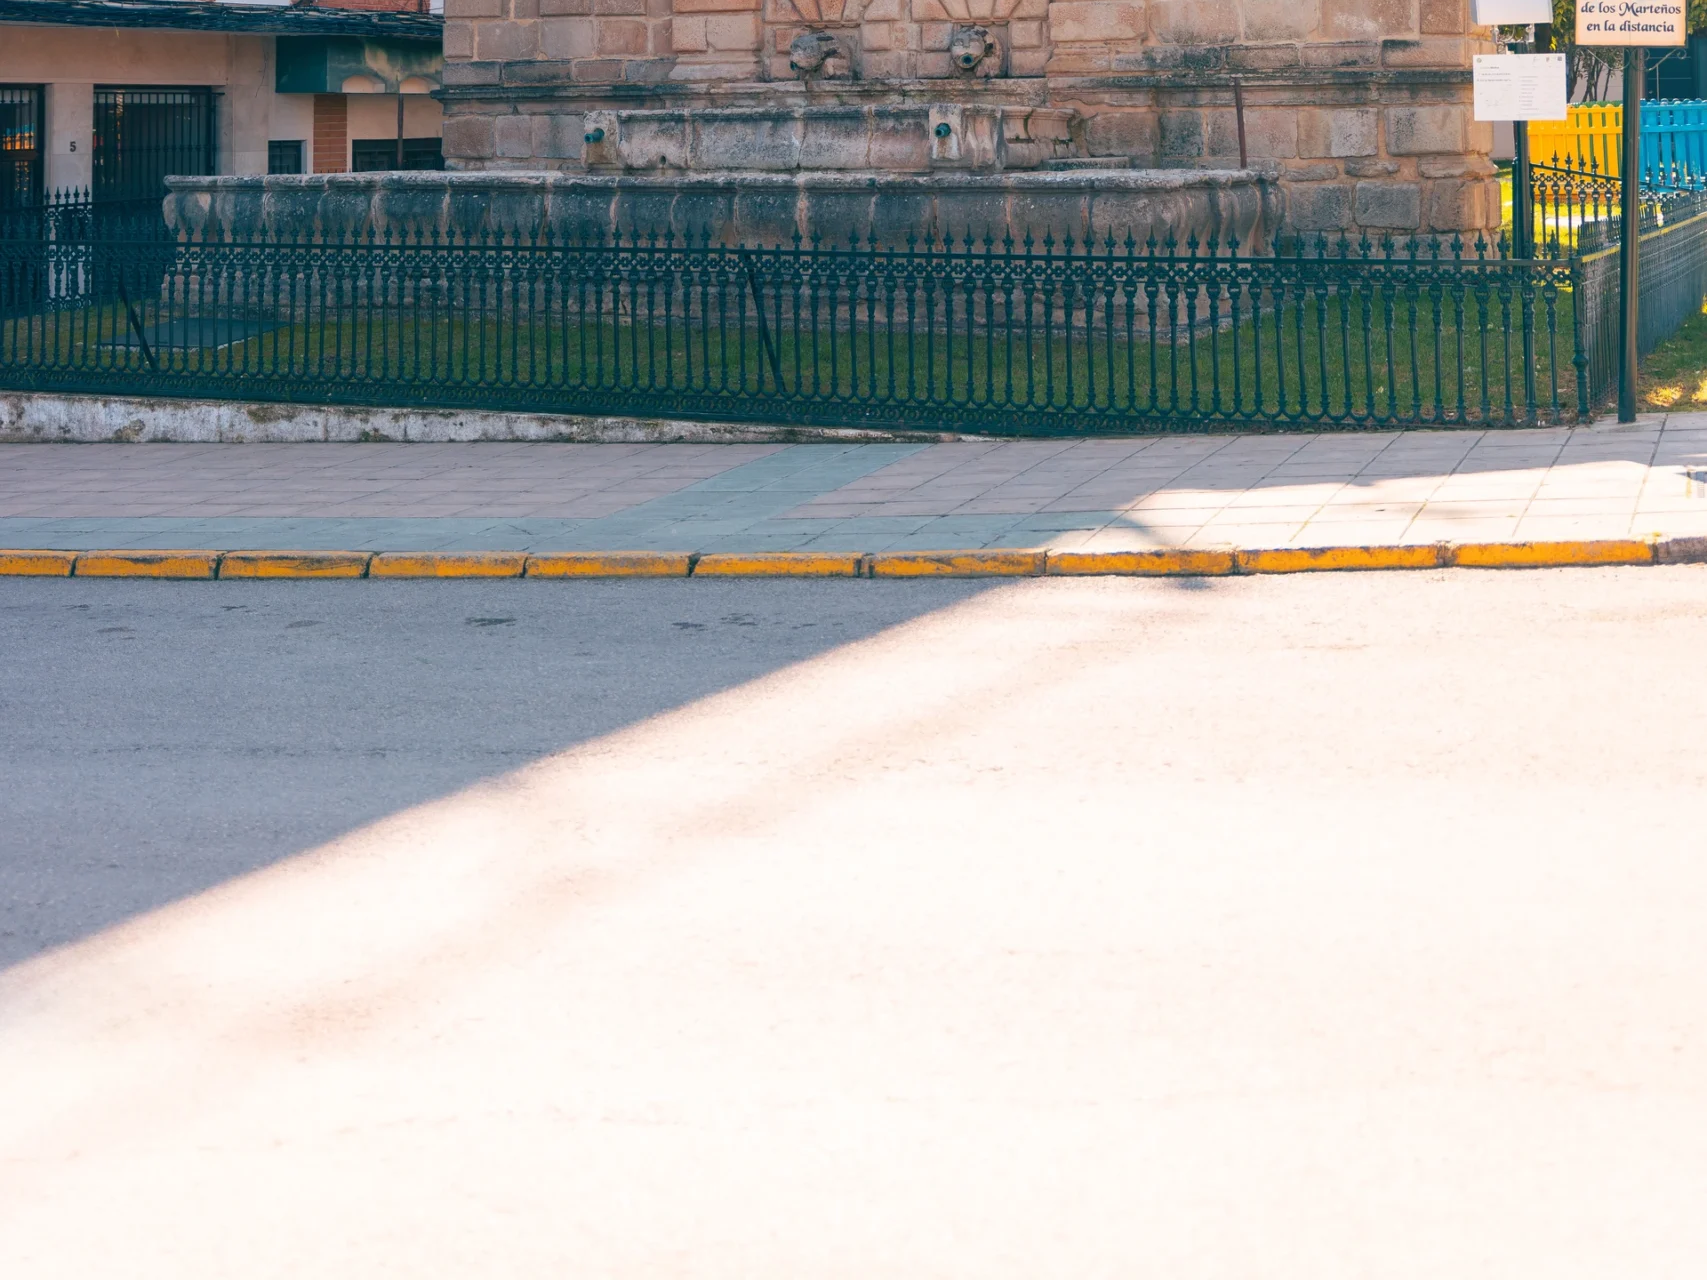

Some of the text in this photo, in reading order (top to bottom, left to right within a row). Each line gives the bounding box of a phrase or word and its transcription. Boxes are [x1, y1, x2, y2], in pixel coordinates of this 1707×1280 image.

[1581, 2, 1681, 17] de los Marteños
[1587, 20, 1674, 32] en la distancia
[69, 141, 77, 152] 5
